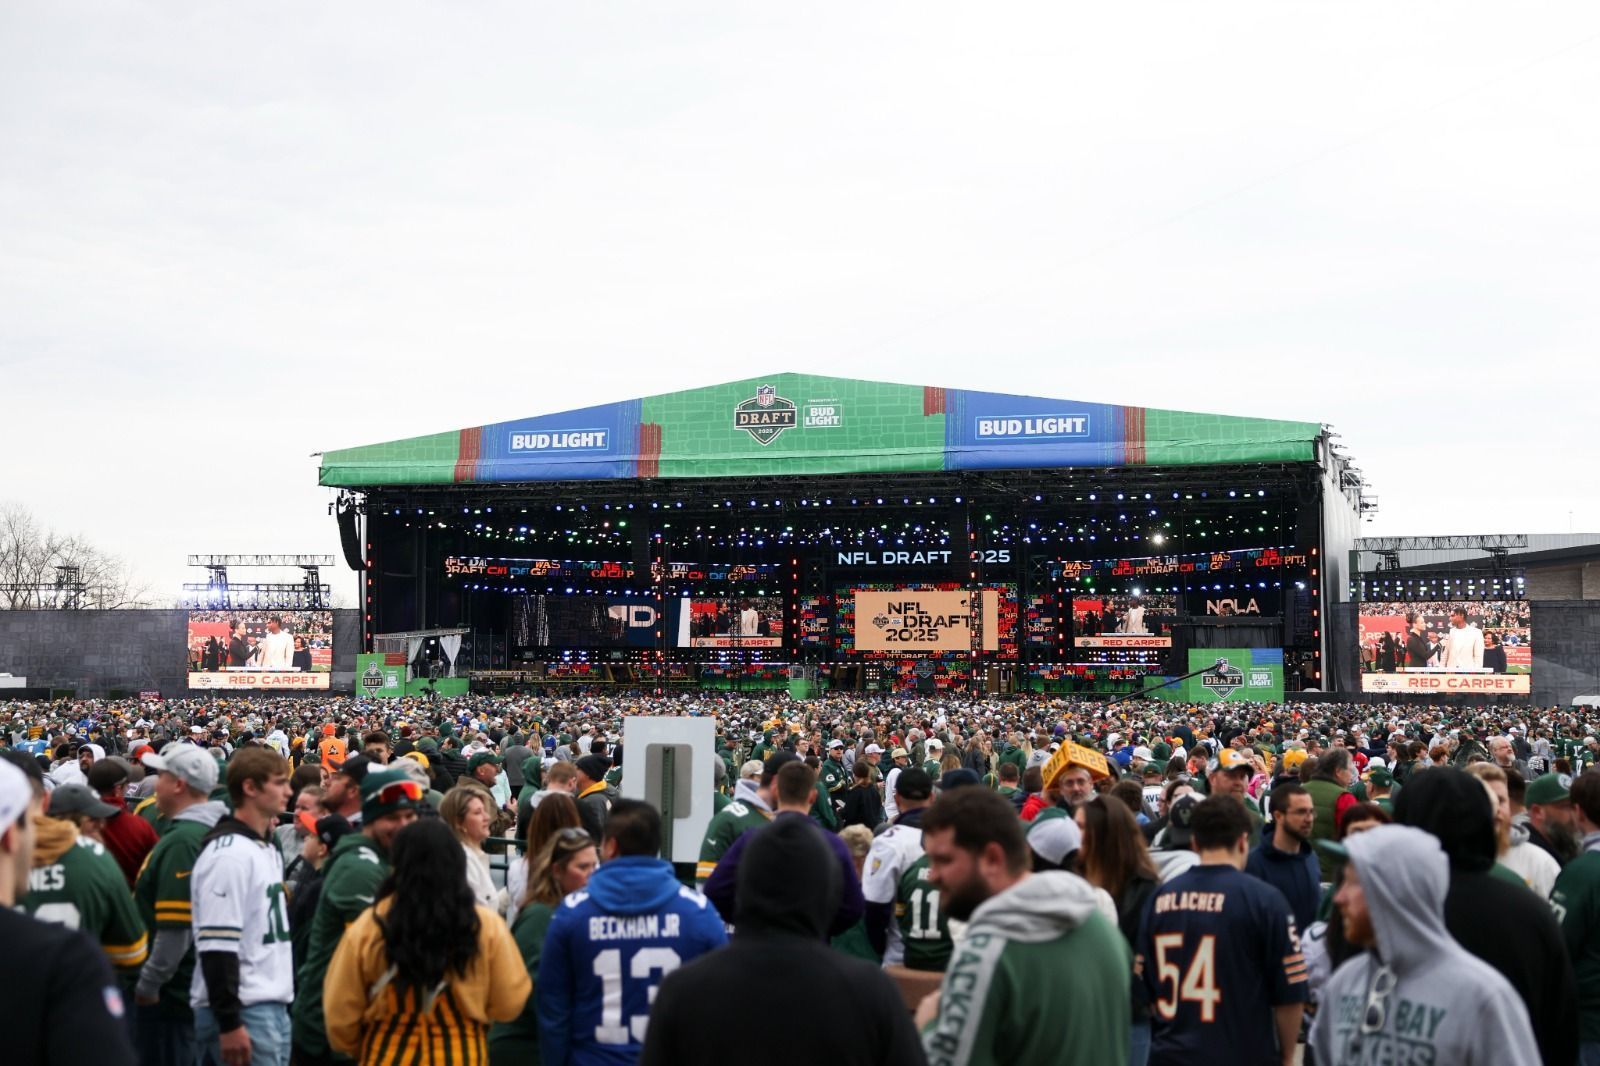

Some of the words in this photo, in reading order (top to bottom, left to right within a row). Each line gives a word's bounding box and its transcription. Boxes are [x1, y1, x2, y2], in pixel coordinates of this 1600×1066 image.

[759, 395, 774, 406] NFL
[739, 412, 792, 424] DRAFT
[810, 407, 835, 417] BUD
[805, 416, 840, 426] LIGHT
[979, 420, 1022, 436] BUD
[1025, 418, 1085, 434] LIGHT
[512, 434, 550, 449] BUD
[552, 432, 606, 448] LIGHT
[838, 552, 877, 565] NFL
[882, 551, 952, 564] DRAFT
[970, 550, 1011, 563] 025
[1151, 564, 1180, 574] DRAFT
[887, 602, 928, 614] NFL
[1206, 598, 1260, 614] NOLA
[903, 615, 971, 628] DRAFT
[885, 629, 940, 642] 2025
[229, 676, 256, 685] RED
[261, 676, 318, 685] CARPET
[363, 678, 382, 686] DRAFT
[1205, 676, 1241, 684] DRAFT
[1408, 678, 1440, 688] RED
[1447, 679, 1516, 689] CARPET
[1069, 745, 1107, 771] 2025
[27, 864, 66, 891] NES
[1155, 892, 1226, 914] URLACHER
[909, 887, 942, 939] 11
[589, 915, 658, 941] BECKHAM
[660, 914, 680, 937] JR
[1154, 932, 1222, 1023] 54
[593, 947, 682, 1044] 13
[1395, 998, 1447, 1040] BAY
